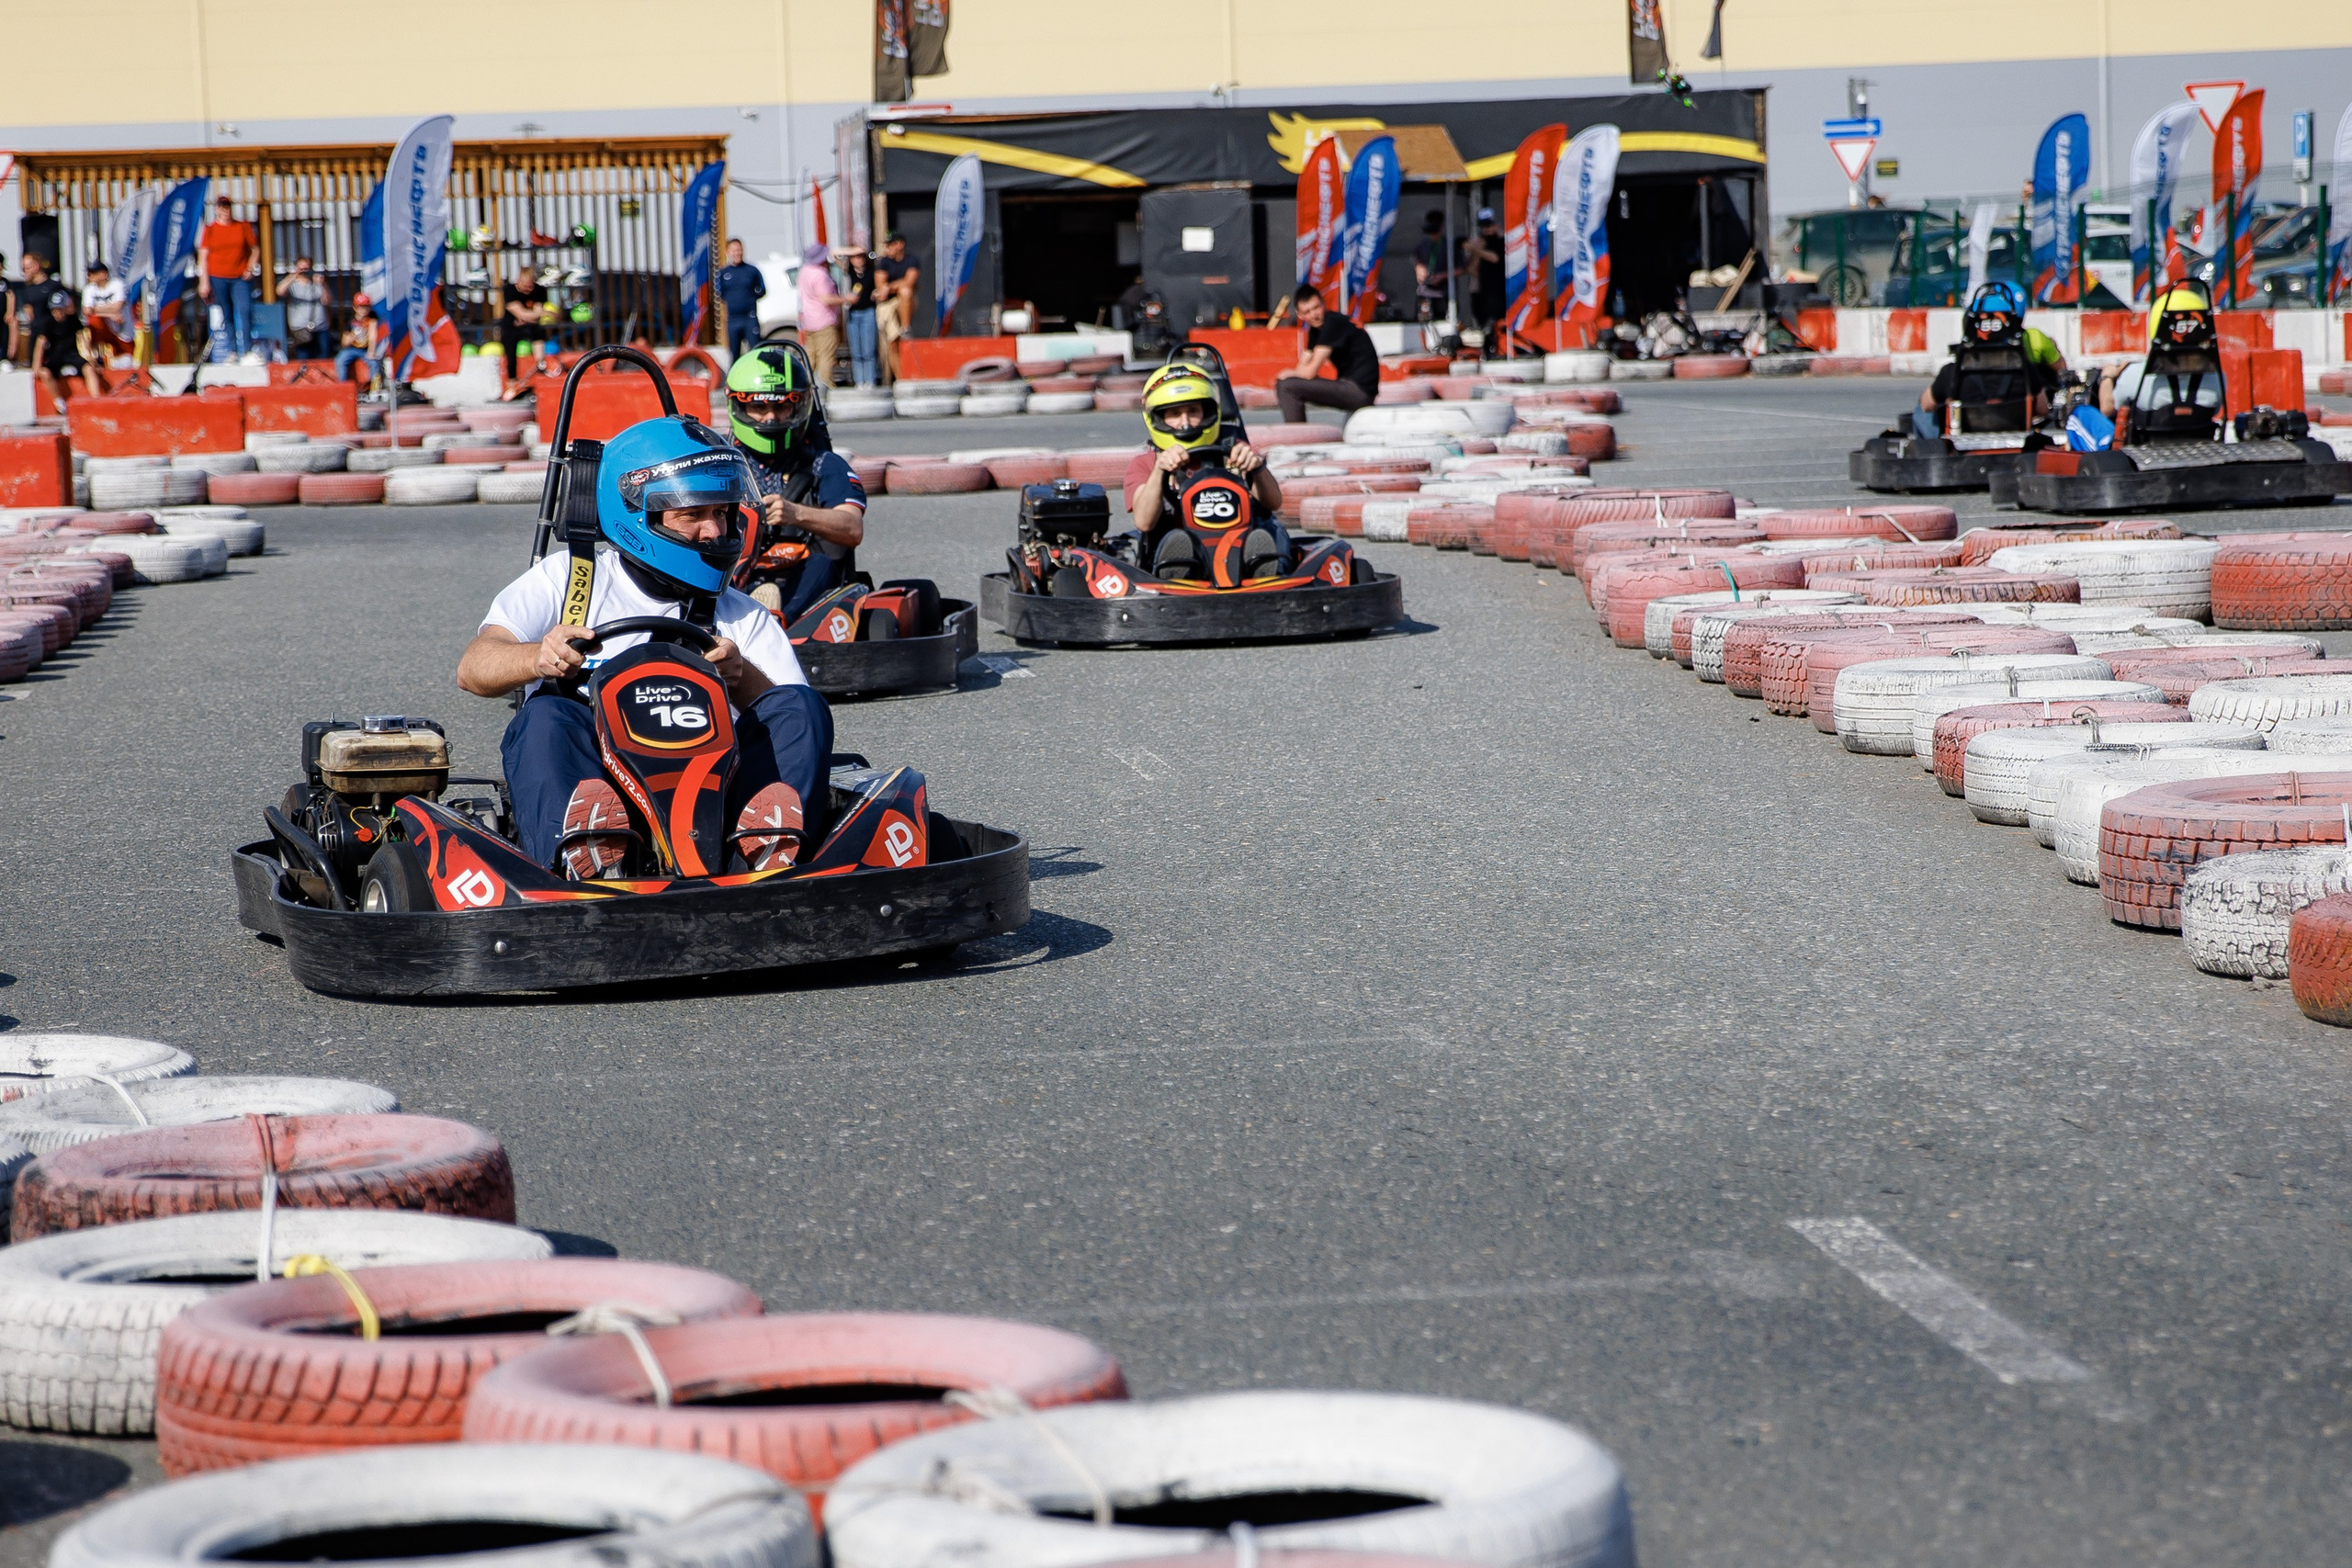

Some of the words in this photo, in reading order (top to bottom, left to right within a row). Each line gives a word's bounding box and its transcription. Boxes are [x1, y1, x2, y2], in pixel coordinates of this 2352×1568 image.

[1193, 502, 1235, 517] 50
[616, 524, 643, 551] GSB
[636, 686, 673, 695] Live
[636, 695, 682, 704] Drive
[650, 705, 707, 728] 16
